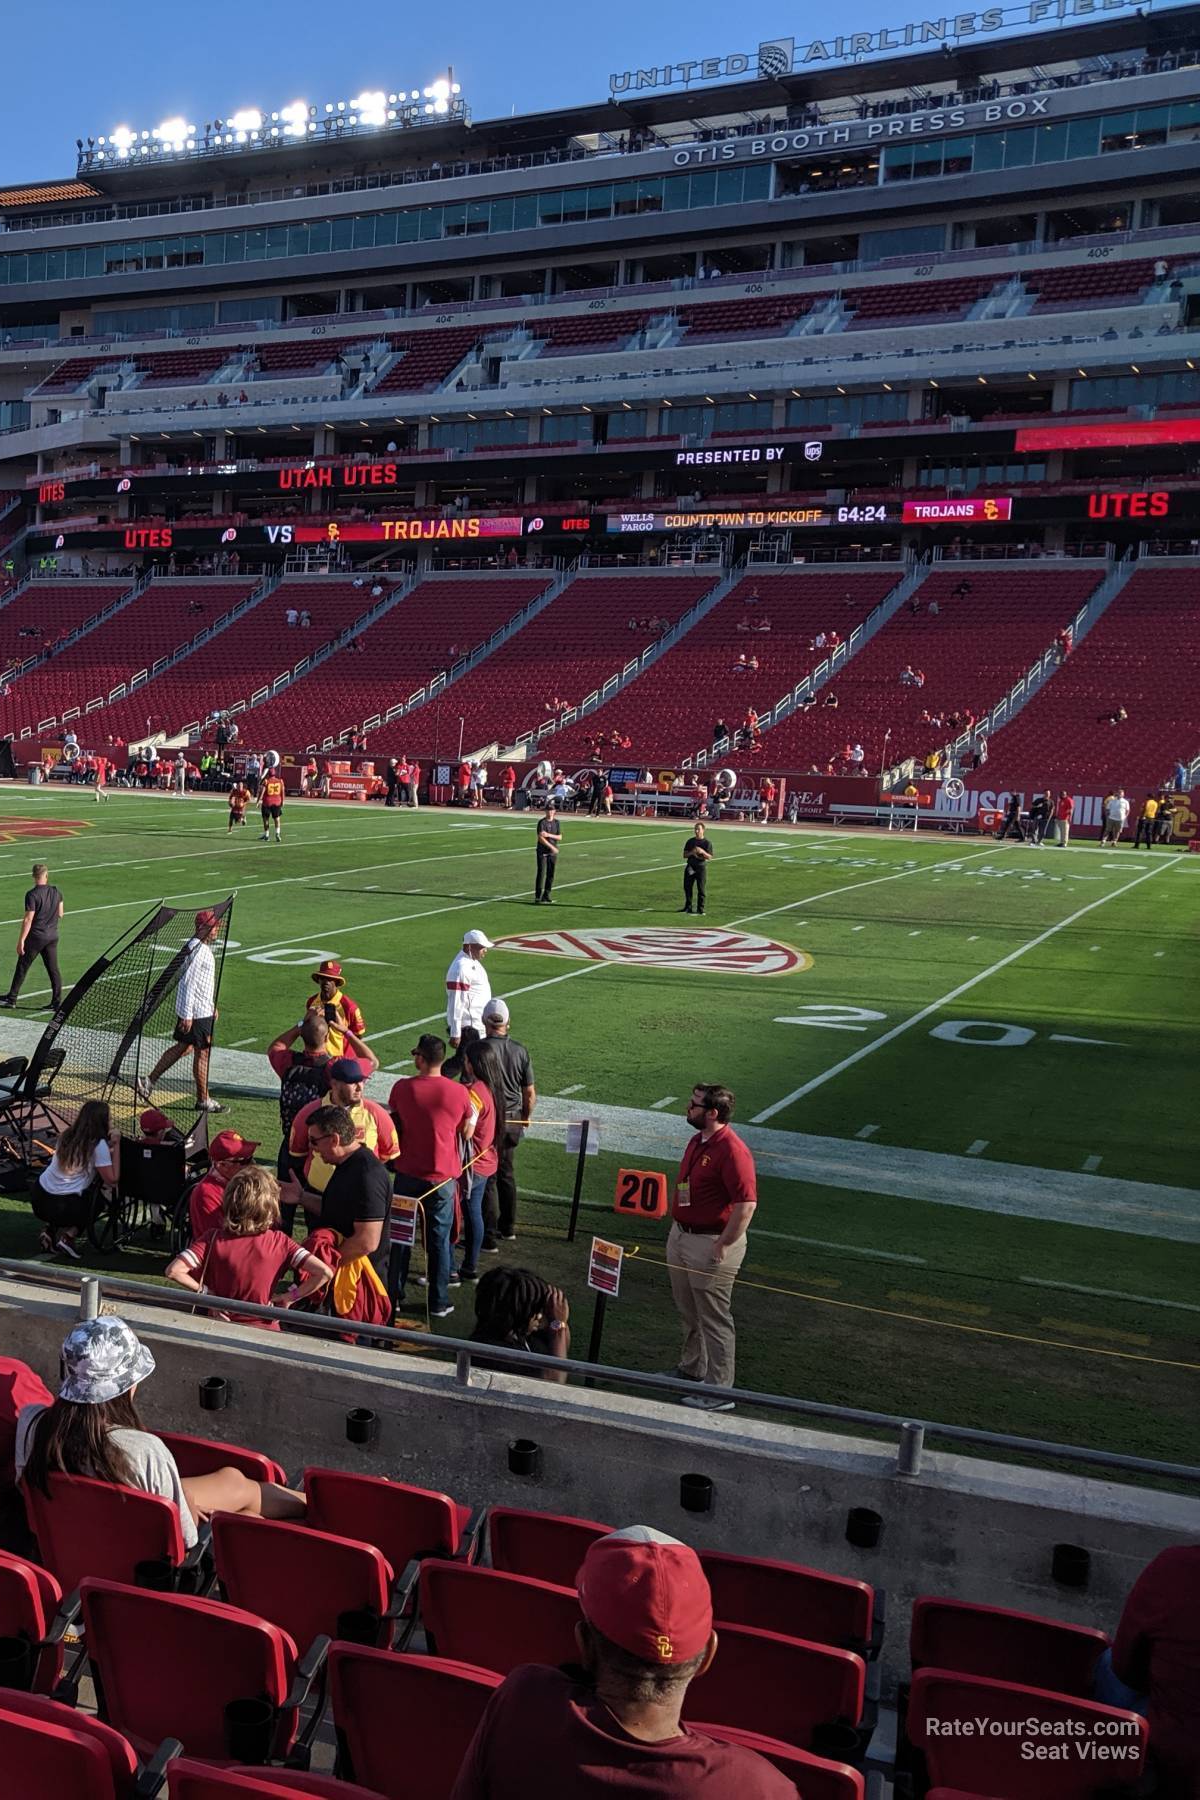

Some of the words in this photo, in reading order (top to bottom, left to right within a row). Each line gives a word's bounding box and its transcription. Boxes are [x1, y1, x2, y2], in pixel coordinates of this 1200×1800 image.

[609, 53, 747, 94] UNITED
[803, 7, 1003, 62] AIRLINES
[673, 143, 735, 168] OTIS
[751, 127, 851, 158] BOOTH
[867, 111, 966, 139] PRESS
[984, 97, 1052, 123] BOX
[914, 265, 936, 277] 407
[744, 284, 763, 293] 406
[588, 300, 606, 309] 405
[311, 326, 326, 335] 403
[100, 344, 112, 352] 401
[186, 337, 200, 346] 402
[677, 449, 761, 466] PRESENTED
[766, 448, 784, 461] BY
[279, 466, 332, 489] UTAH
[343, 464, 397, 486] UTES
[40, 482, 65, 503] UTES
[838, 506, 887, 522] 64:24
[914, 504, 975, 519] TROJANS
[1089, 492, 1169, 519] UTES
[562, 519, 590, 530] UTES
[621, 513, 654, 523] WELLS
[621, 522, 654, 532] FARGO
[665, 513, 745, 528] COUNTDOWN
[748, 512, 764, 525] TO
[767, 509, 822, 524] KICKOFF
[268, 525, 293, 544] VS
[382, 518, 480, 540] TROJANS
[124, 528, 173, 549] UTES
[983, 814, 996, 825] G
[772, 1004, 1038, 1047] 20
[620, 1174, 660, 1212] 20
[657, 1635, 673, 1658] SC
